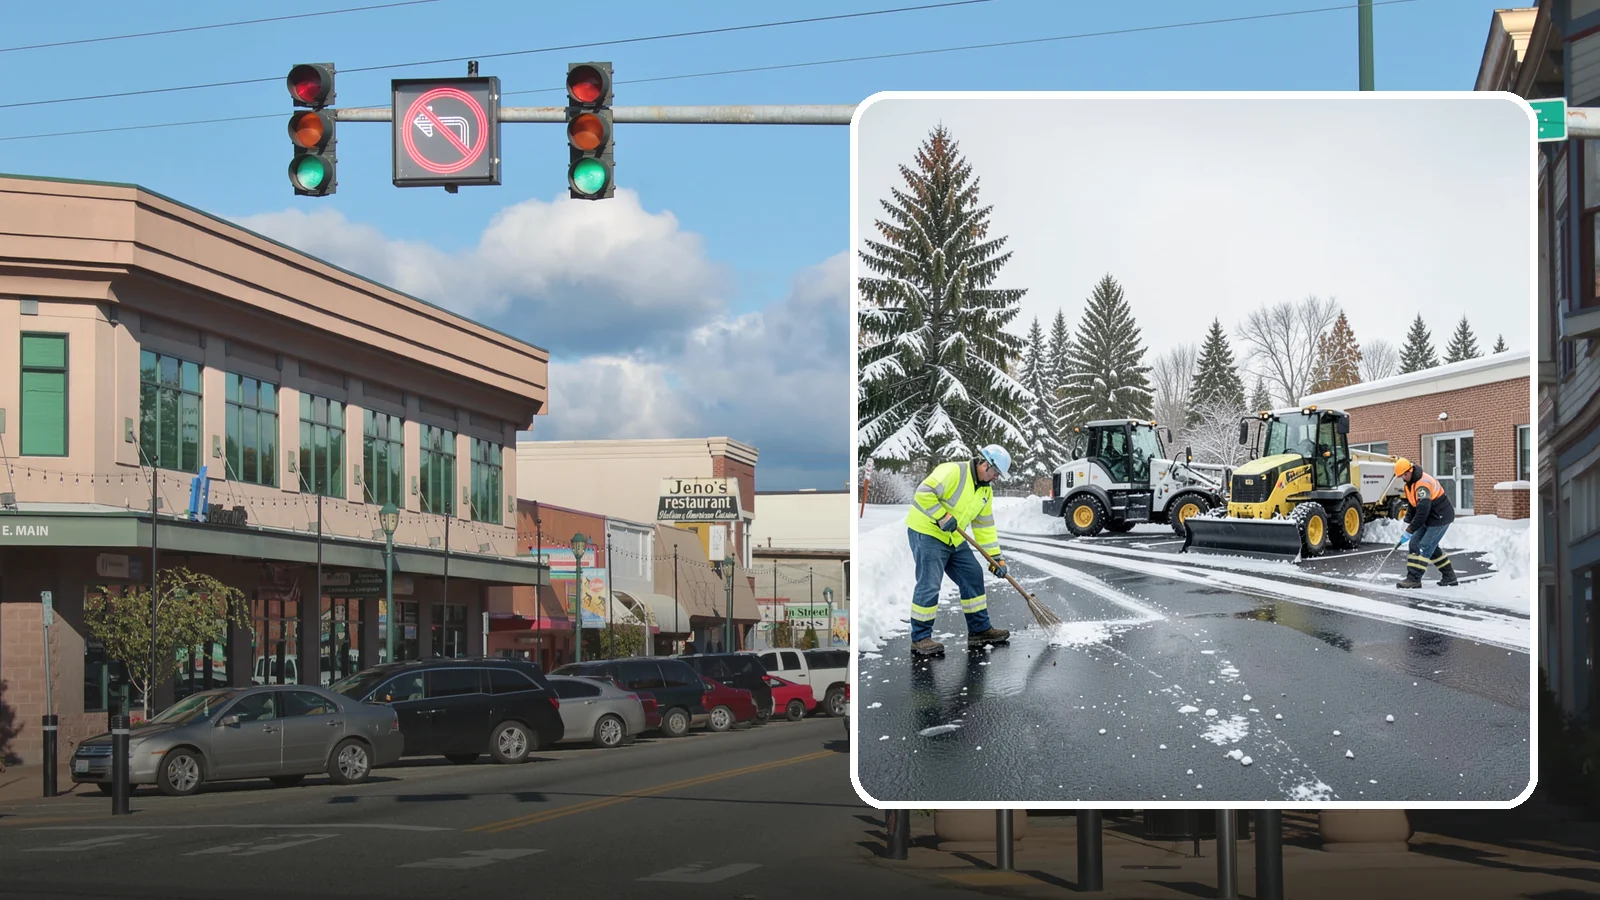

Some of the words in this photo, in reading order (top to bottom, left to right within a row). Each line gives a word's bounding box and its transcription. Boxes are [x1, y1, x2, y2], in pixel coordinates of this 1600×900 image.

[669, 480, 727, 494] Jeno's
[665, 496, 731, 509] restaurant
[658, 509, 682, 520] Italian
[685, 509, 714, 519] American
[714, 509, 738, 519] Cuisine
[2, 525, 13, 536] E.
[15, 525, 49, 536] MAIN
[797, 608, 828, 616] Street
